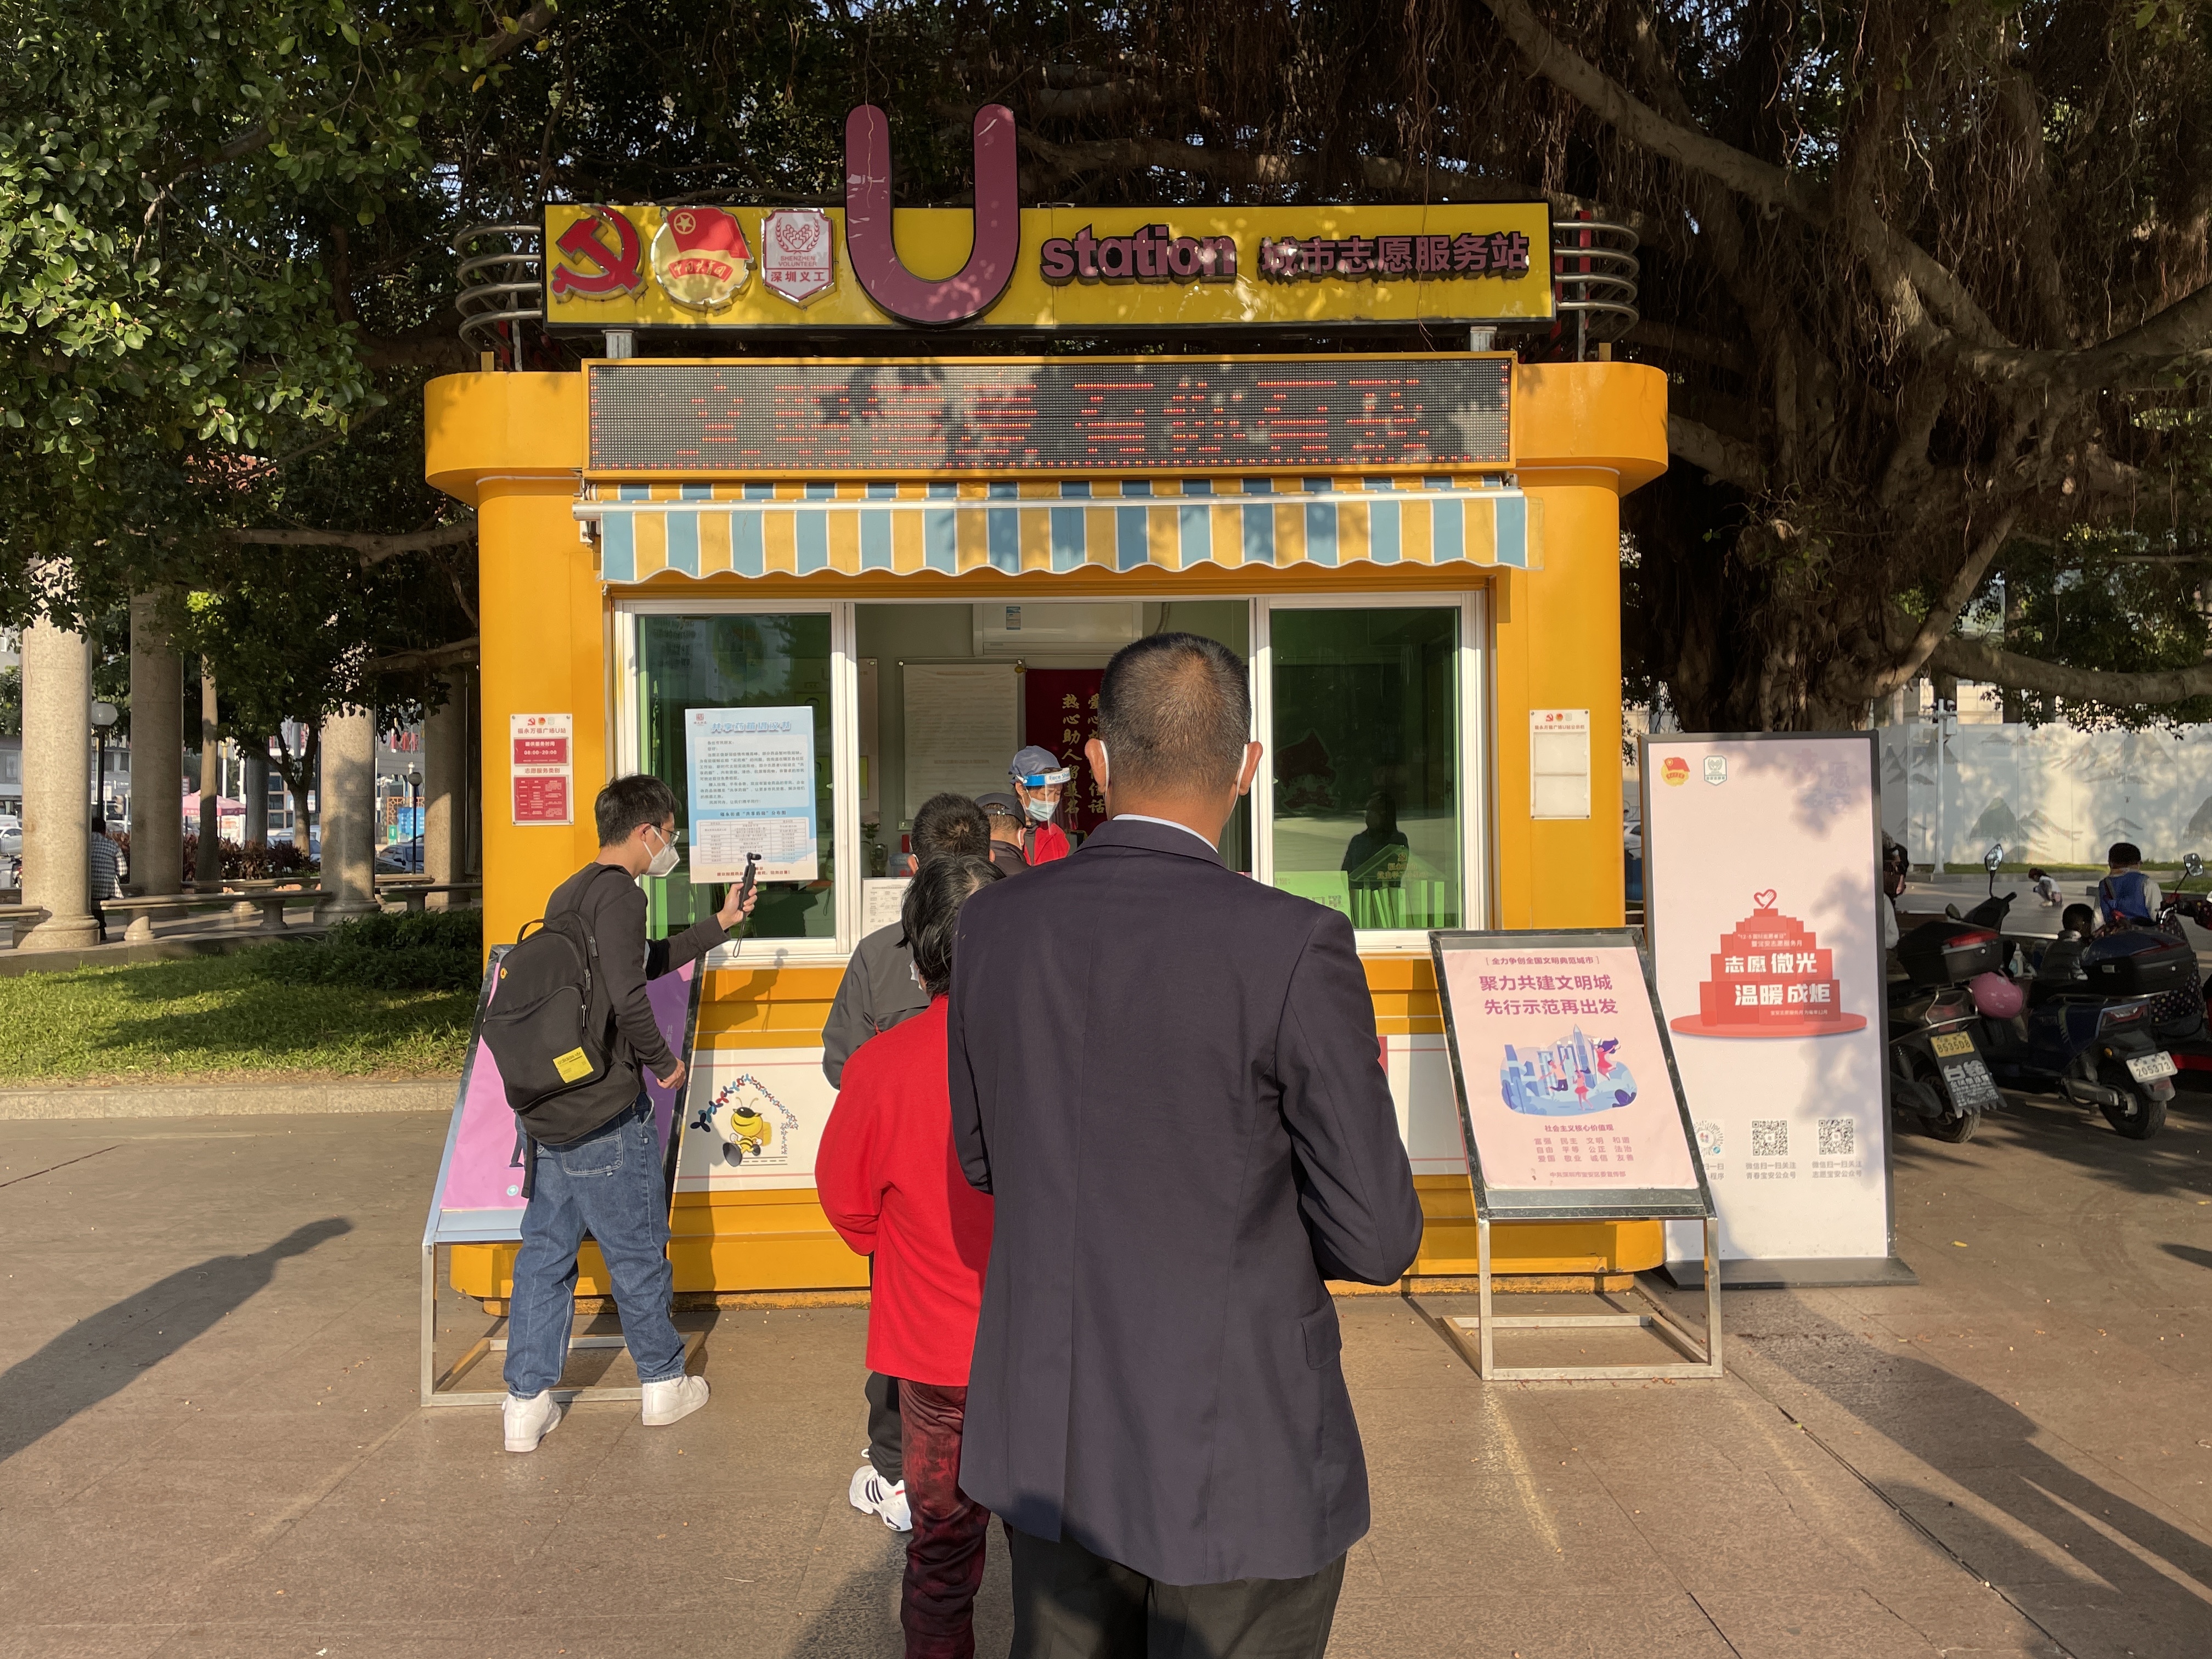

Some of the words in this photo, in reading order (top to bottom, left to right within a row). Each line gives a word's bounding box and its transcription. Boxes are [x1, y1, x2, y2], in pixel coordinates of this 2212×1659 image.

[845, 103, 1020, 328] U
[1040, 222, 1237, 282] station
[1260, 231, 1531, 278] 城市志愿服务站
[770, 271, 826, 283] 深圳义工
[1724, 952, 1818, 975] 志愿微光
[1479, 974, 1613, 991] 聚力共建文明城
[1735, 983, 1831, 1007] 温暖成炬
[1484, 998, 1619, 1015] 先行示范再出发
[557, 1055, 575, 1065] adidas
[1544, 1124, 1615, 1132] 社会主义核心价值观
[1533, 1137, 1553, 1146] 富强
[1560, 1137, 1578, 1146] 民主
[1585, 1137, 1604, 1146] 文明
[1536, 1145, 1554, 1154] 自由
[1562, 1145, 1579, 1154] 平等
[1588, 1145, 1607, 1154] 公正
[1614, 1145, 1633, 1154] 法治
[1538, 1154, 1556, 1163] 爱国
